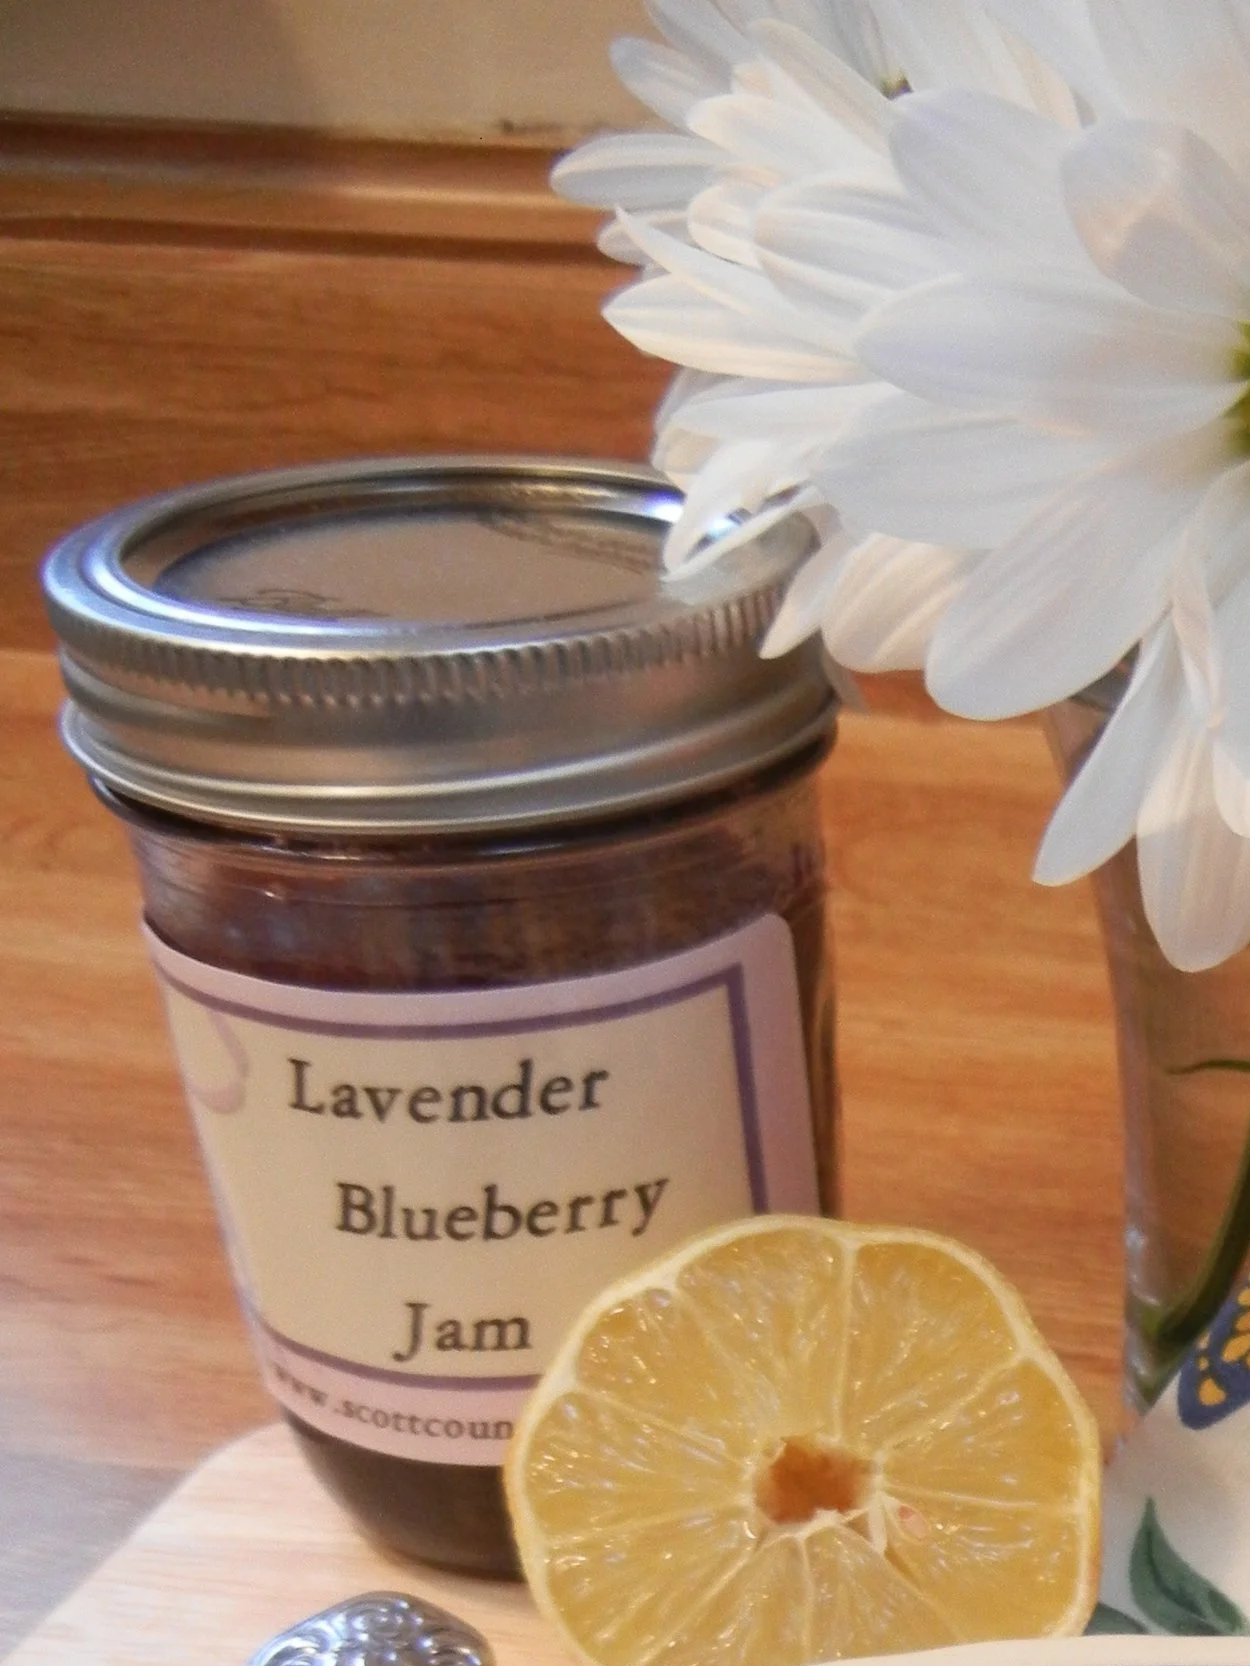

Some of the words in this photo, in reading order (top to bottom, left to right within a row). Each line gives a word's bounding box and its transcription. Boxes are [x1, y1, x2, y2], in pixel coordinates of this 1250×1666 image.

[288, 1058, 609, 1124] Lavender
[335, 1177, 669, 1241] Blueberry
[392, 1301, 532, 1362] Jam
